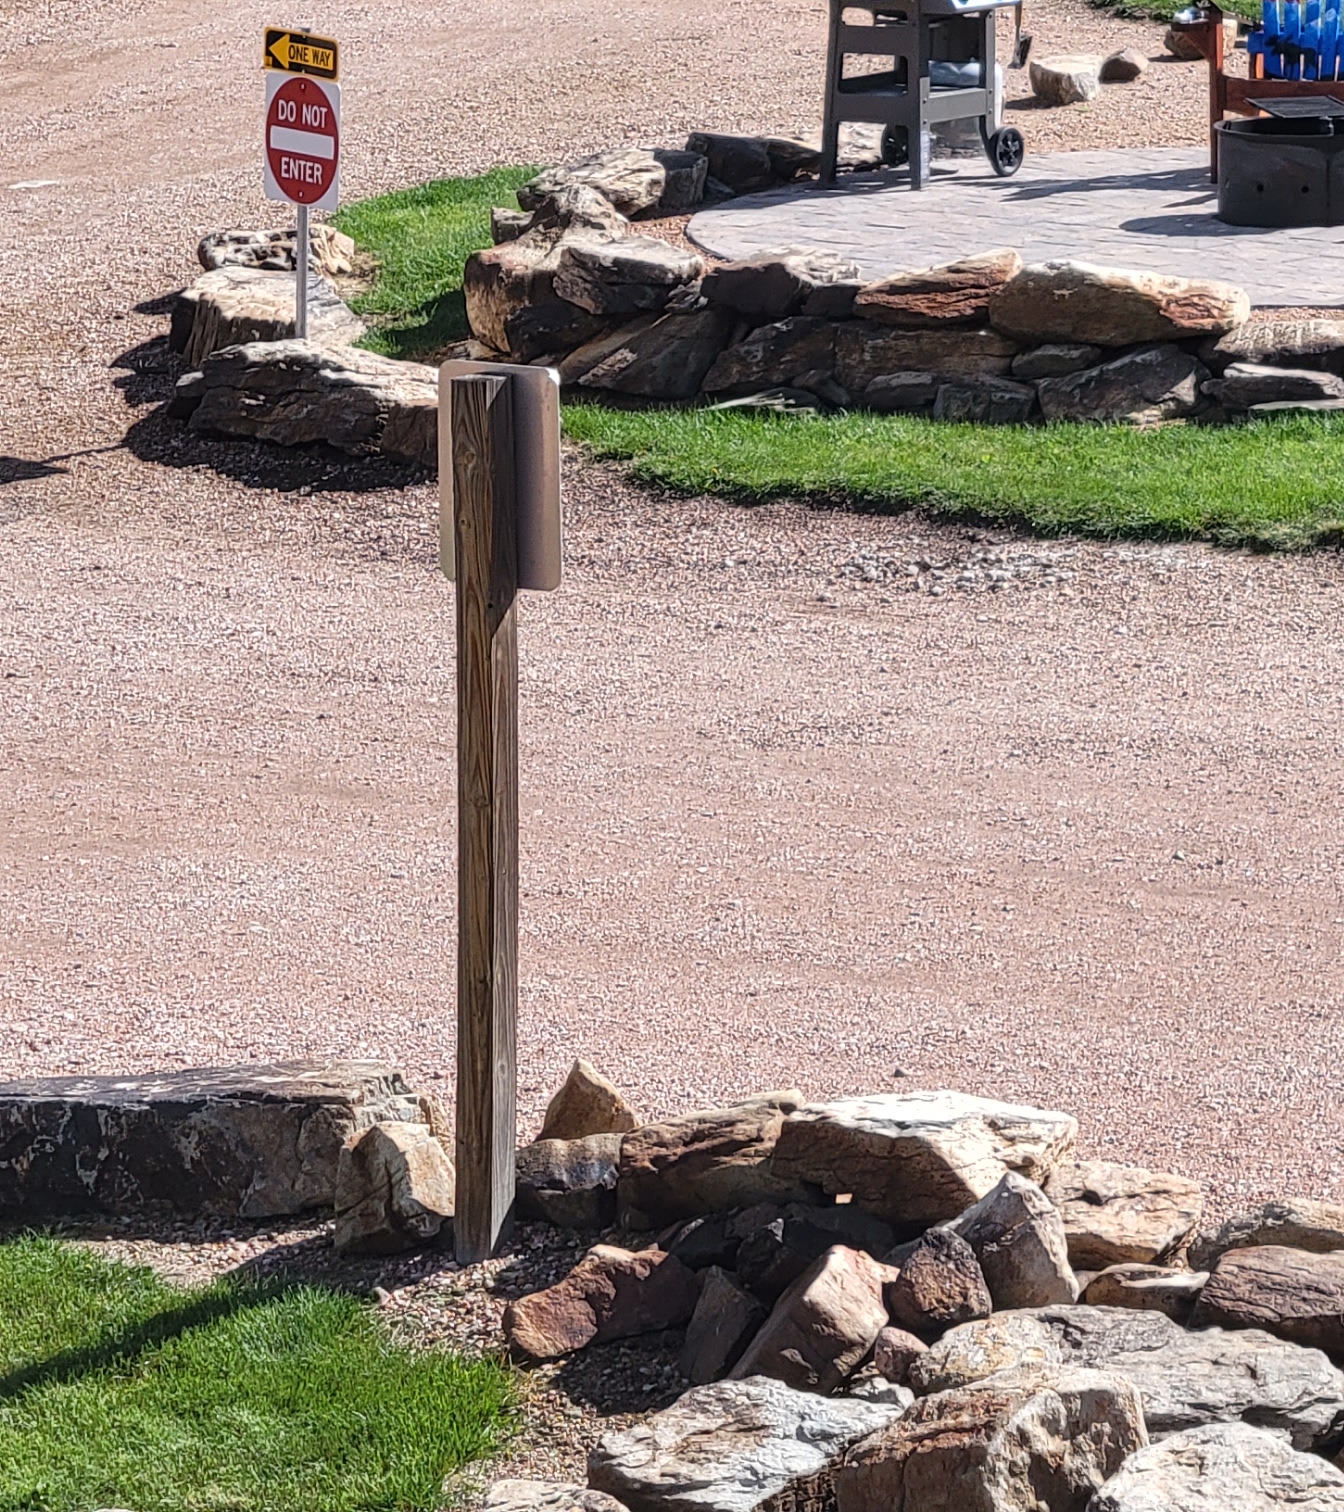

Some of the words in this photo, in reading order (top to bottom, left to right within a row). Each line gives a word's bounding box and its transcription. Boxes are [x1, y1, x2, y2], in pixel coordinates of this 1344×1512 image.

[288, 43, 309, 64] ONE
[311, 48, 331, 67] WAY
[278, 99, 297, 123] DO
[302, 103, 328, 129] NOT
[281, 157, 322, 186] ENTER
